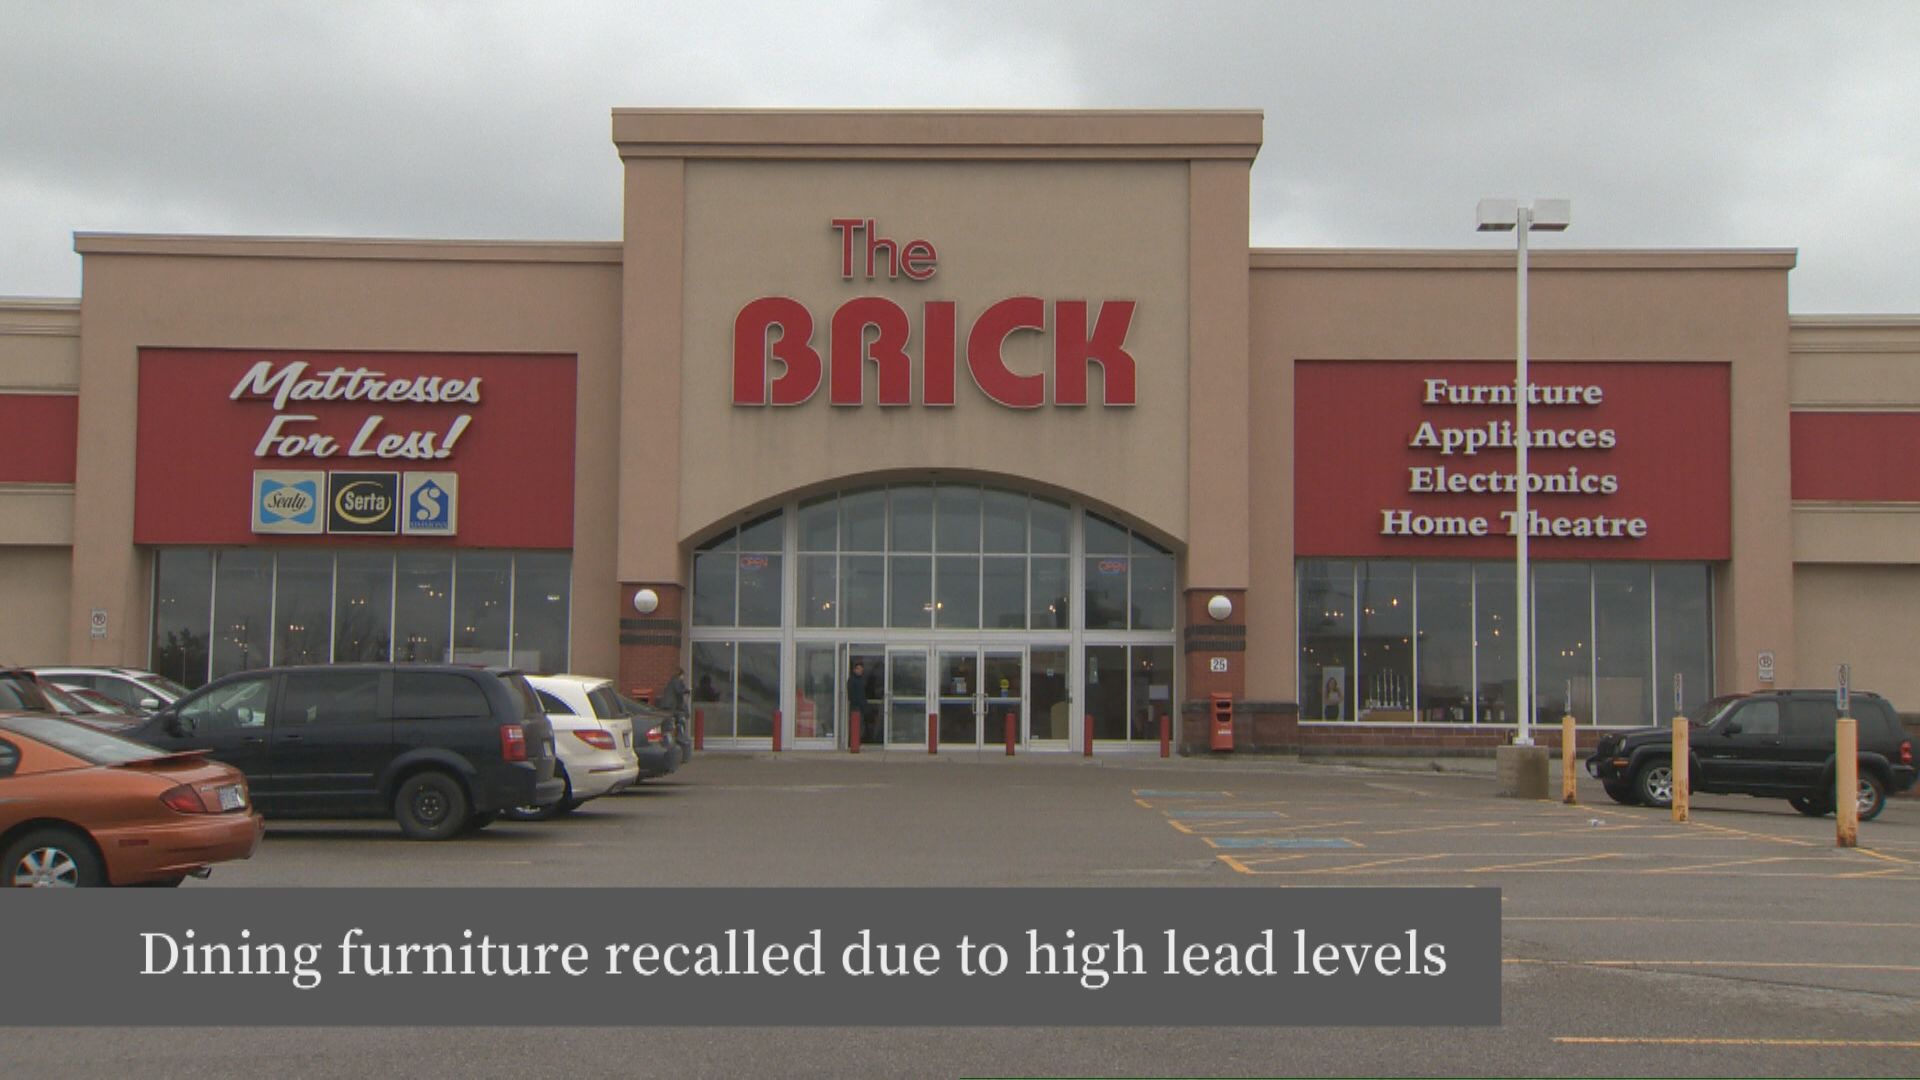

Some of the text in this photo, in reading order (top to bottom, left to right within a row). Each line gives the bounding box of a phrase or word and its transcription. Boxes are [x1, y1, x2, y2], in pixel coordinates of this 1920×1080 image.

[831, 217, 938, 281] The
[732, 295, 1138, 409] BRICK
[229, 360, 483, 411] Mattresses
[254, 414, 473, 459] For Less!
[1408, 465, 1619, 494] Electronics
[266, 491, 307, 512] Sealy
[344, 490, 386, 512] Serta
[1379, 509, 1648, 538] Home Theatre
[1212, 658, 1226, 671] 25
